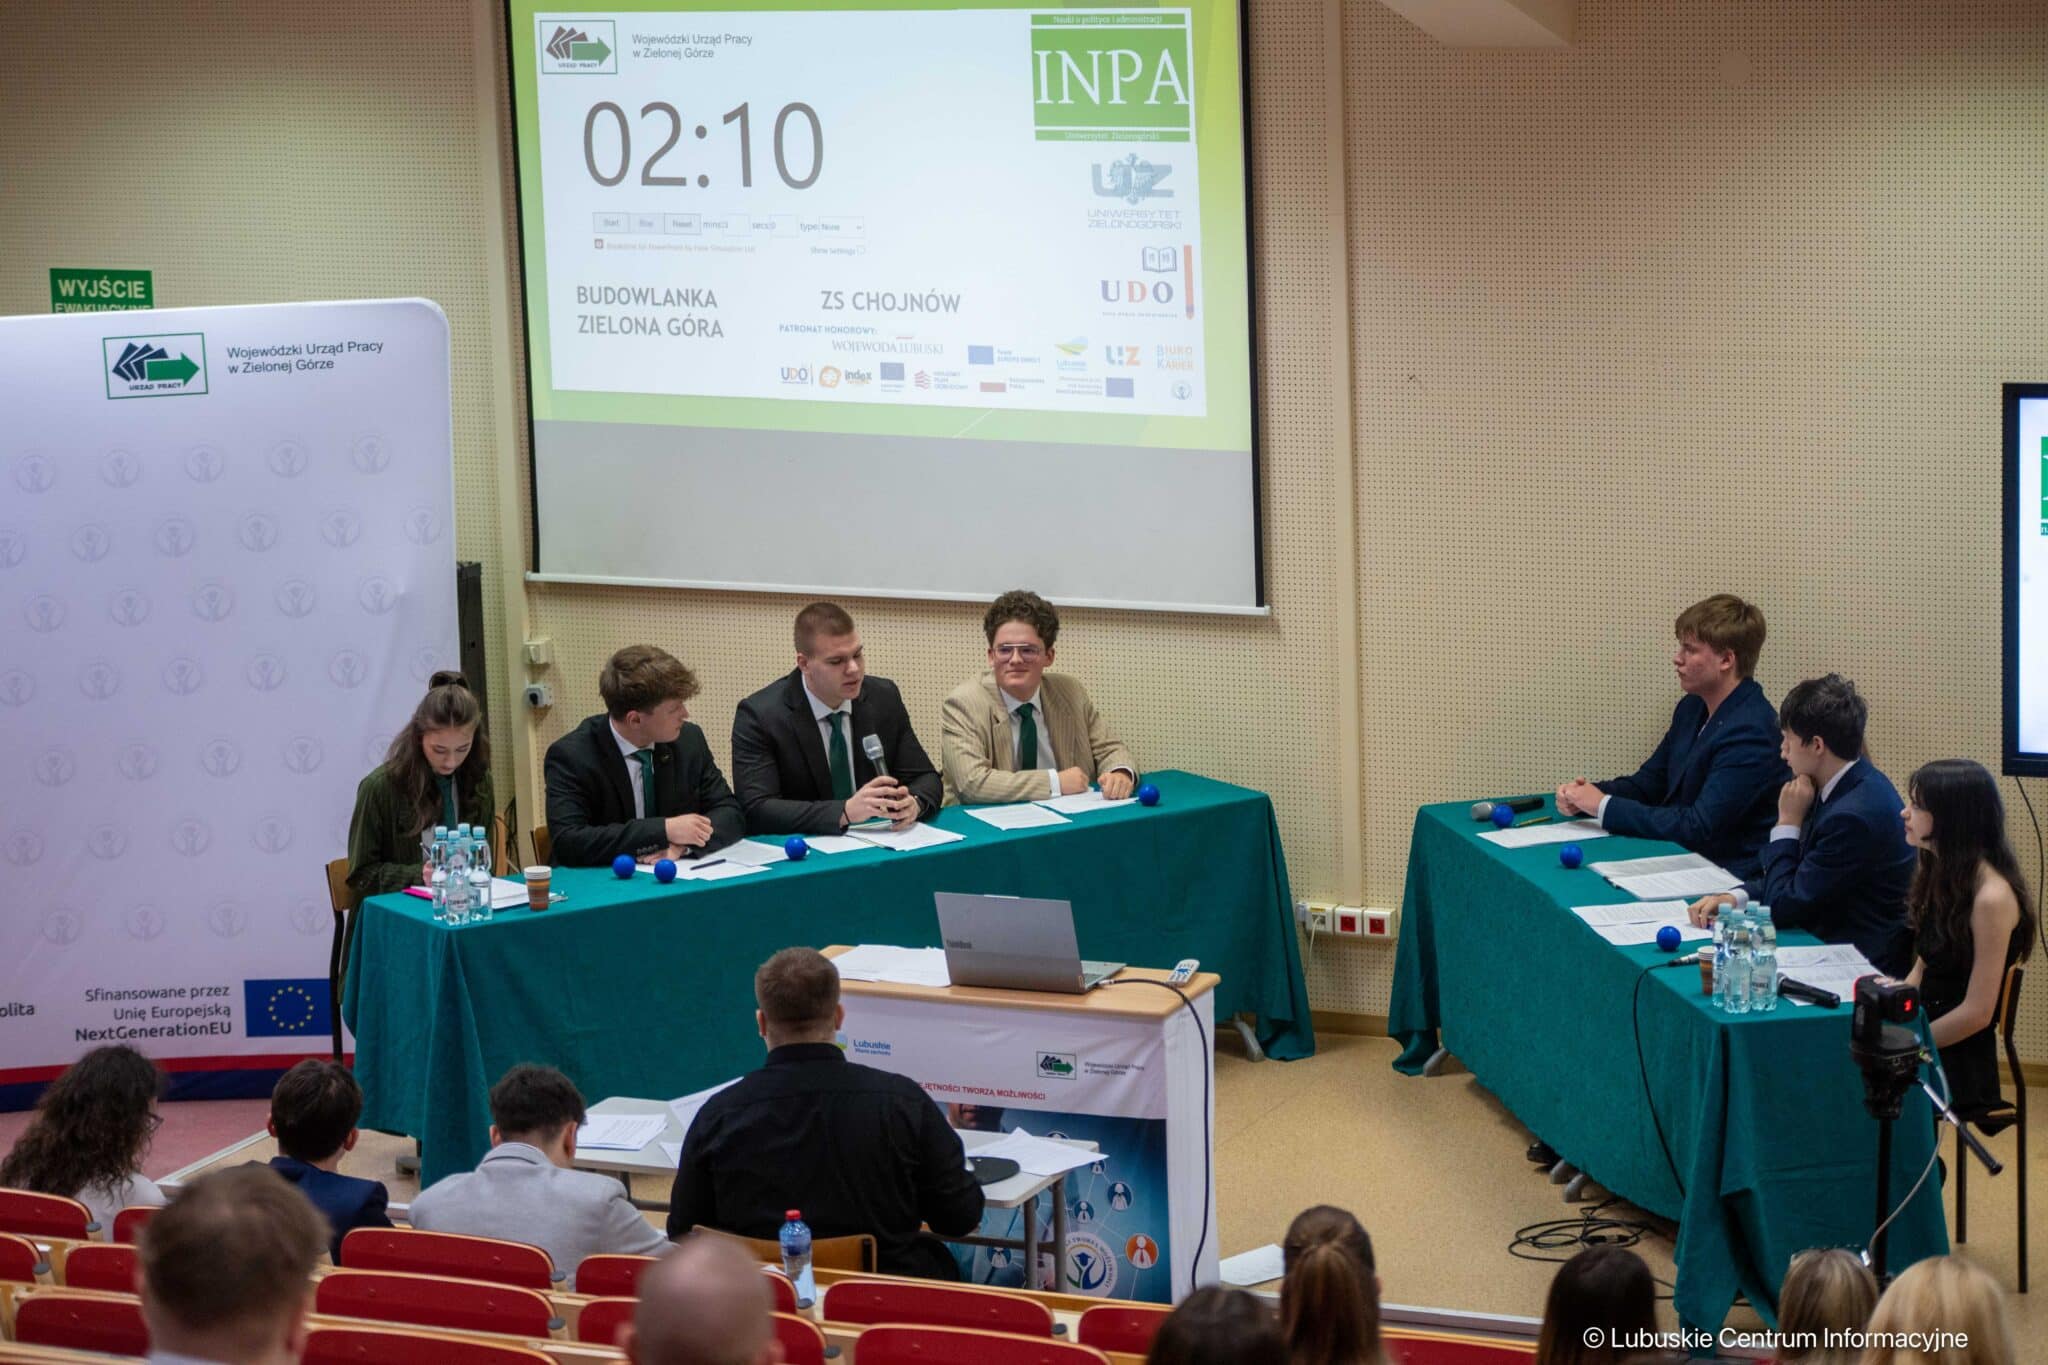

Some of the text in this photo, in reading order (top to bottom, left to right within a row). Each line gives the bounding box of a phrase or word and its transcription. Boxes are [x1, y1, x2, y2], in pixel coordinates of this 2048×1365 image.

[632, 33, 753, 48] Wojewódzki Urząd Pracy
[643, 47, 682, 60] Zielonej
[685, 46, 715, 59] Górze
[1034, 48, 1190, 105] INPA
[583, 101, 824, 190] 02:10
[58, 275, 146, 299] WYJŚCIE
[577, 286, 718, 308] BUDOWLANKA
[1101, 280, 1174, 304] UDO
[820, 288, 961, 313] ZS CHOJNÓW
[577, 314, 724, 338] ZIELONA GÓRA
[779, 324, 822, 334] PATRONAT
[227, 340, 384, 361] Wojewódzki Urząd Pracy
[832, 339, 896, 354] WOJEWODA
[228, 357, 335, 377] w Zielonej Górze
[781, 367, 809, 380] UDO
[85, 985, 230, 1003] Sfinansowane przez
[0, 1002, 35, 1017] olita
[113, 1003, 231, 1021] Unię Europejską
[75, 1021, 232, 1042] NextGenerationEU
[962, 1086, 995, 1098] TWORZĄ
